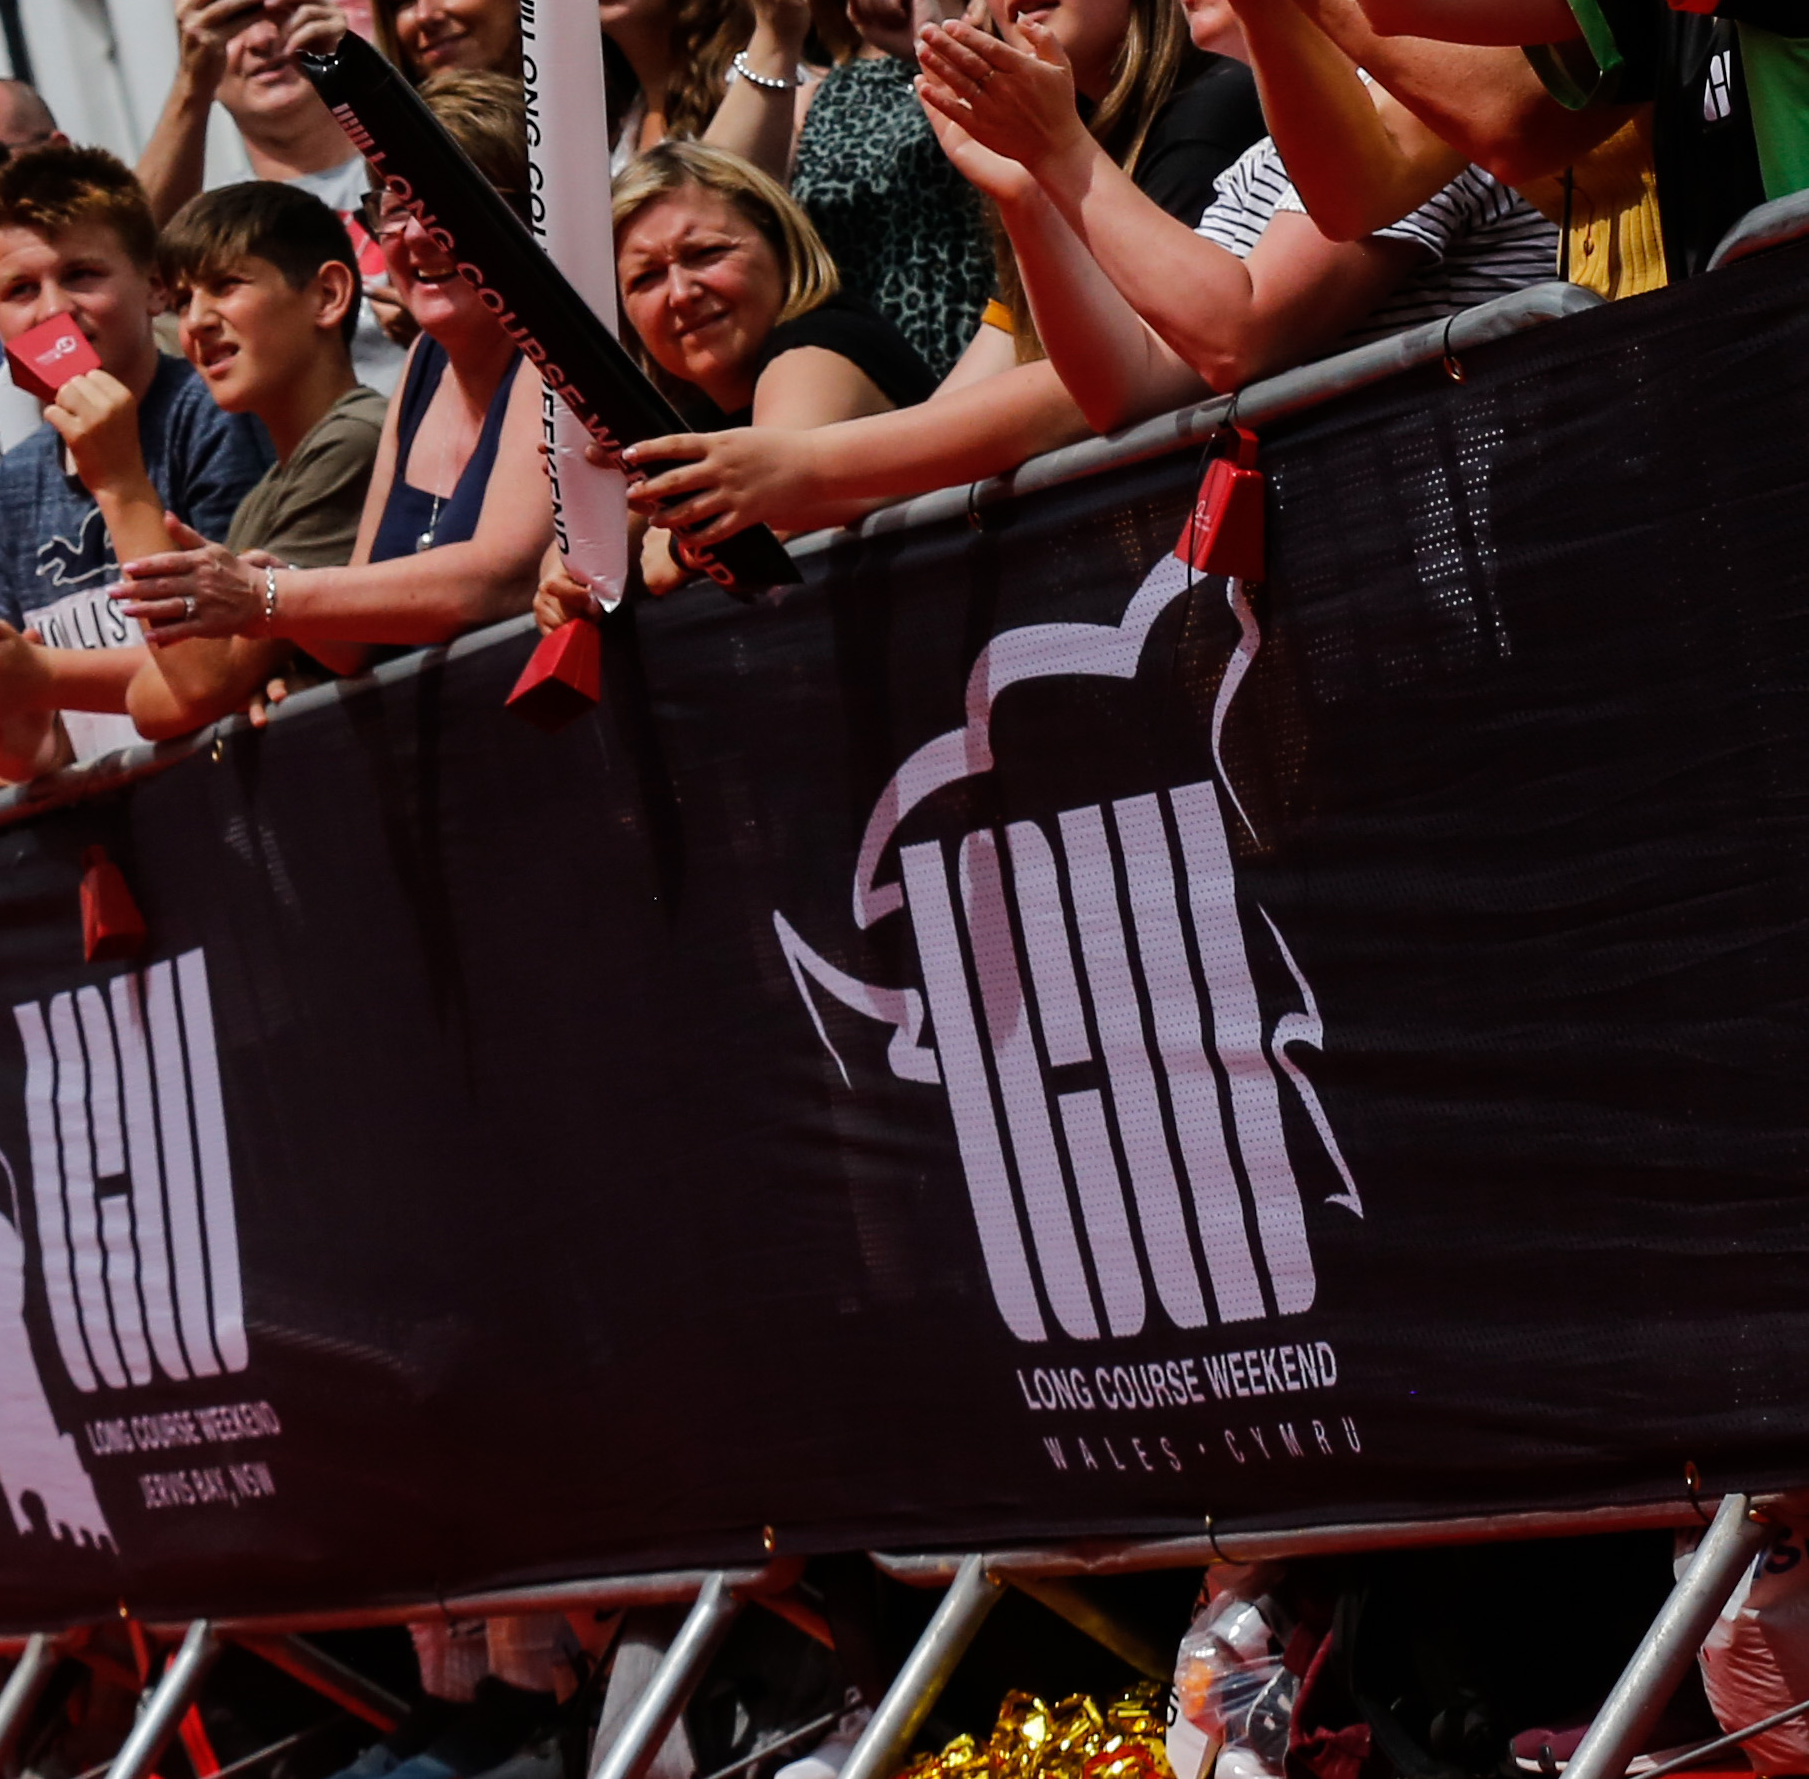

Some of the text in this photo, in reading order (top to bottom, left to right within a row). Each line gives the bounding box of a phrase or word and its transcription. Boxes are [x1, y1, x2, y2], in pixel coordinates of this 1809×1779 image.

[455, 261, 587, 410] COURSE
[1016, 1340, 1338, 1411] LONG COURSE WEEKEND
[84, 1399, 283, 1456] LONG COURSE WEEKEND
[1042, 1415, 1362, 1472] WALES CYMRU
